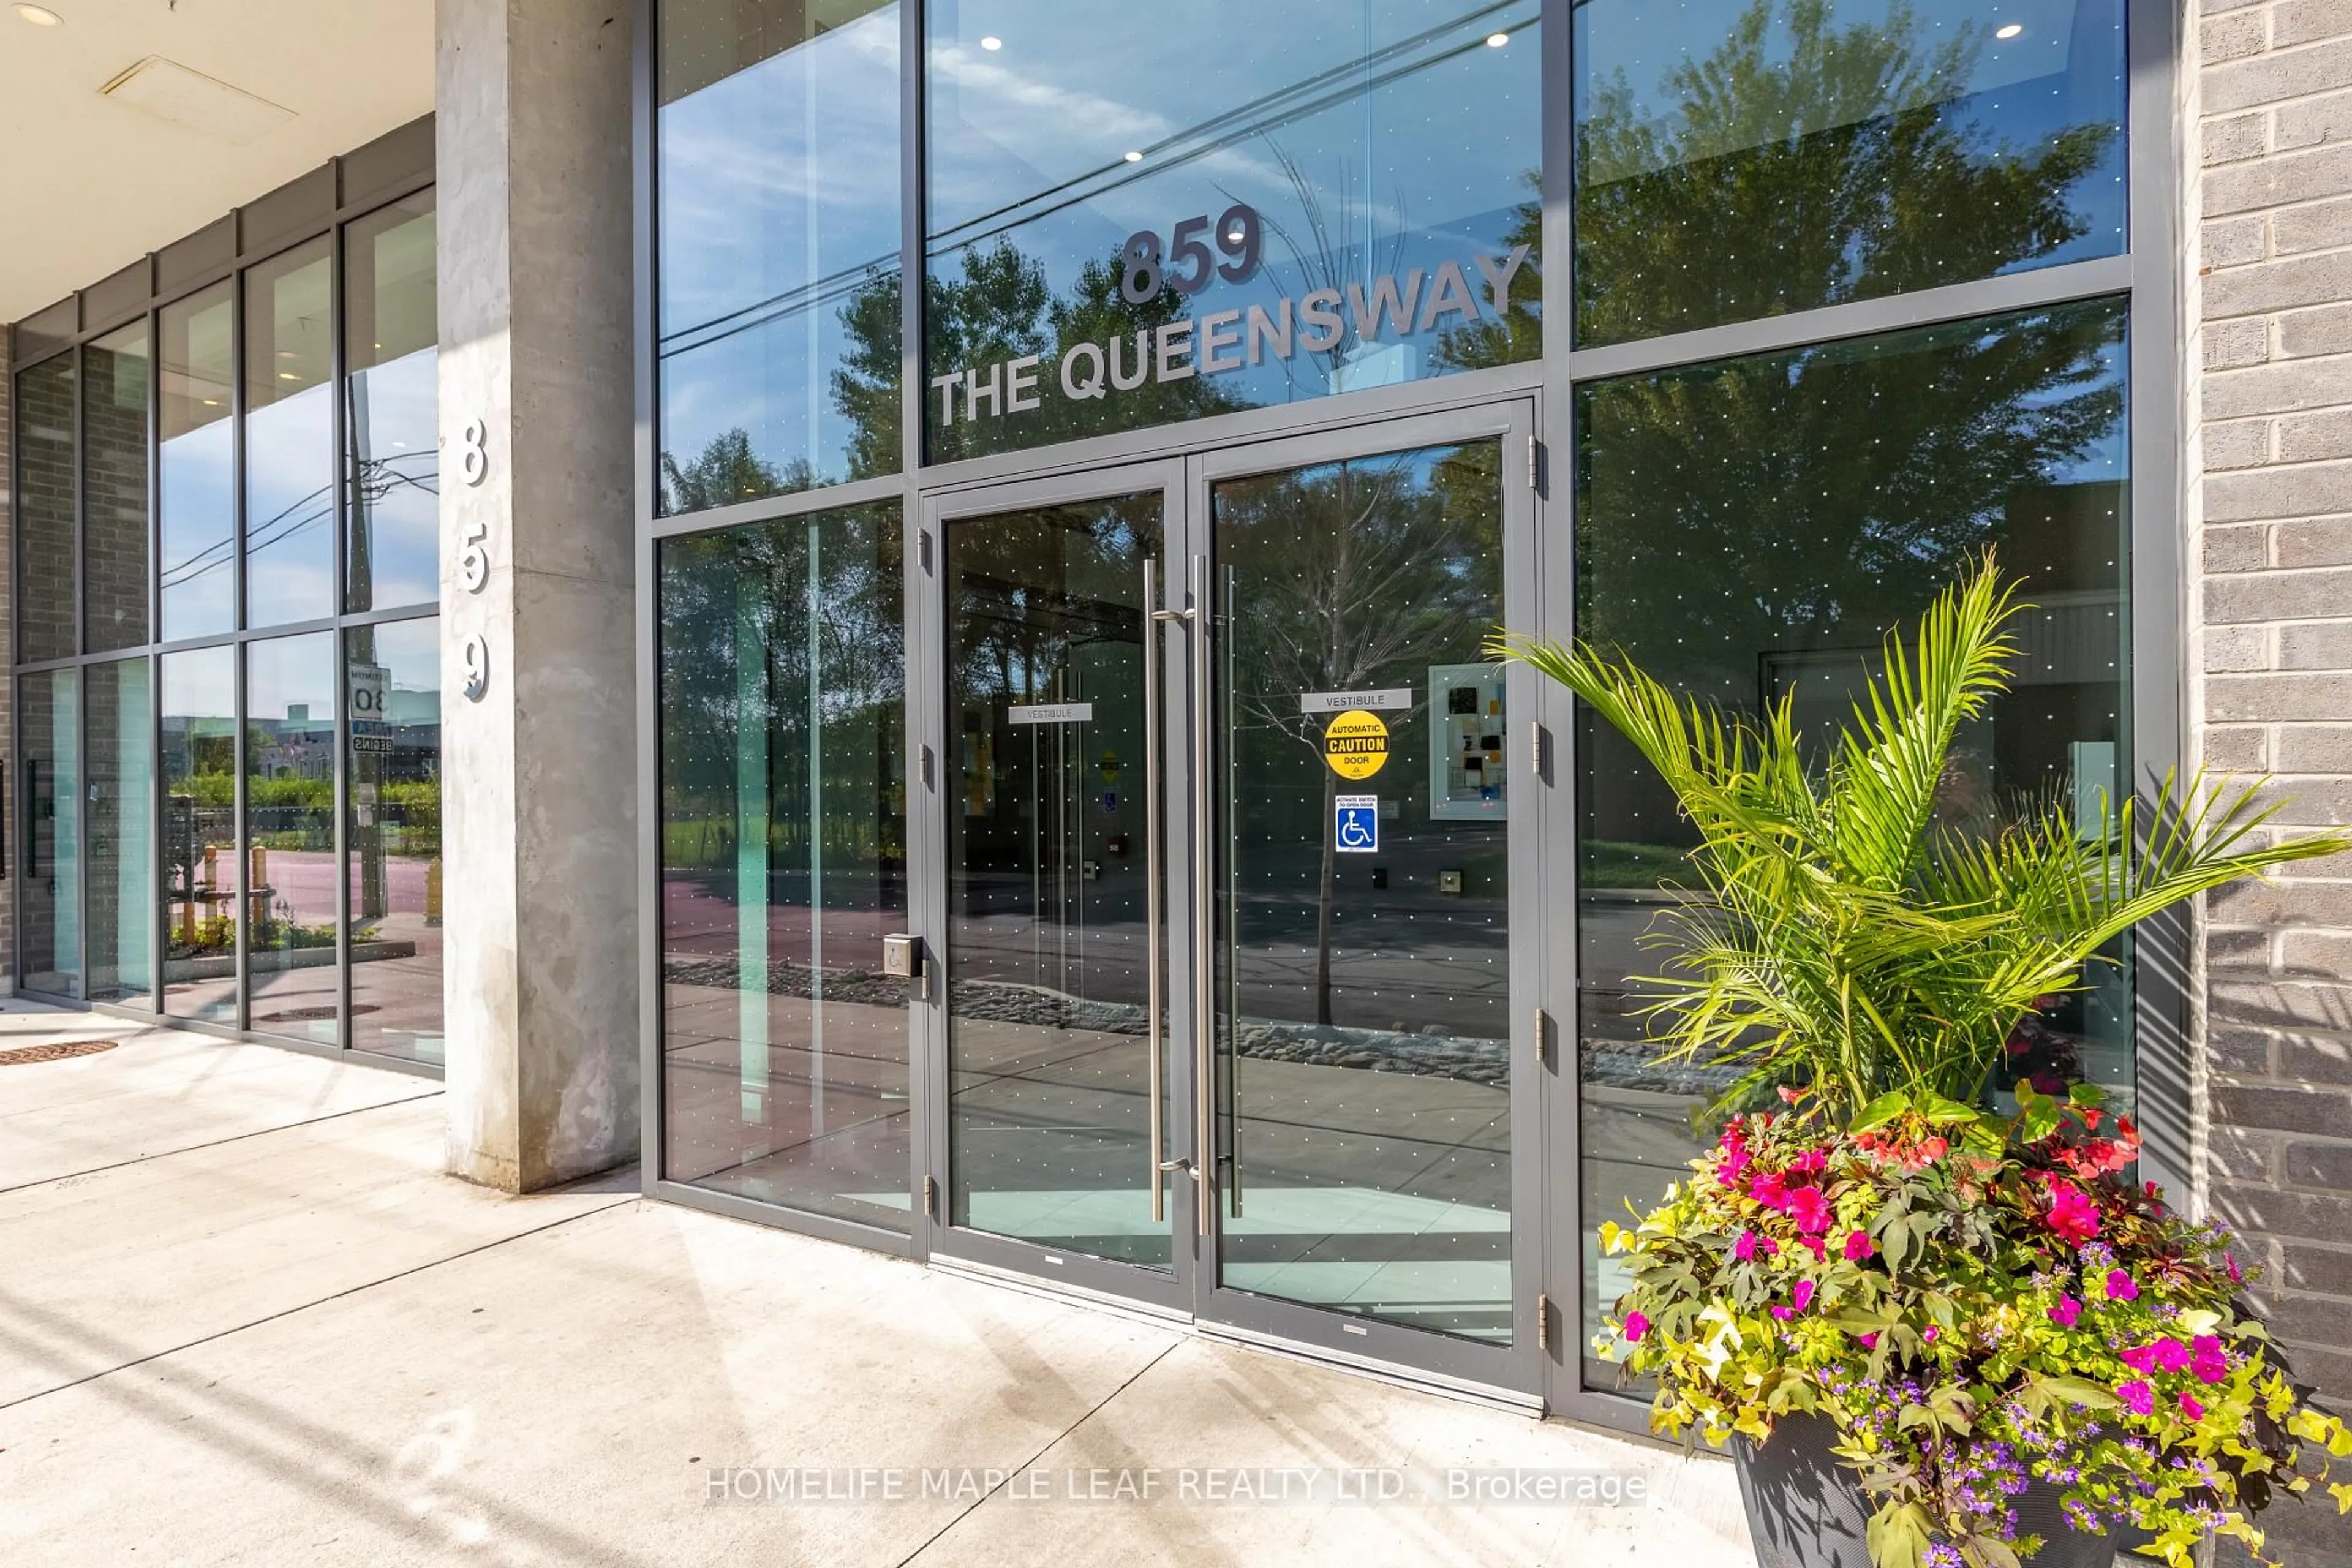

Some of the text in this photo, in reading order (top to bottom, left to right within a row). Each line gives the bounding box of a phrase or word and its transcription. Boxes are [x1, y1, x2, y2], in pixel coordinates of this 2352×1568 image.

[1121, 205, 1261, 304] 859
[932, 244, 1530, 426] THE QUEENSWAY
[458, 417, 489, 703] 859
[1326, 695, 1385, 707] VESTIBULE
[1027, 709, 1072, 719] VESTIBULE
[1332, 725, 1381, 734] AUTOMATIC
[1329, 738, 1385, 752] CAUTION
